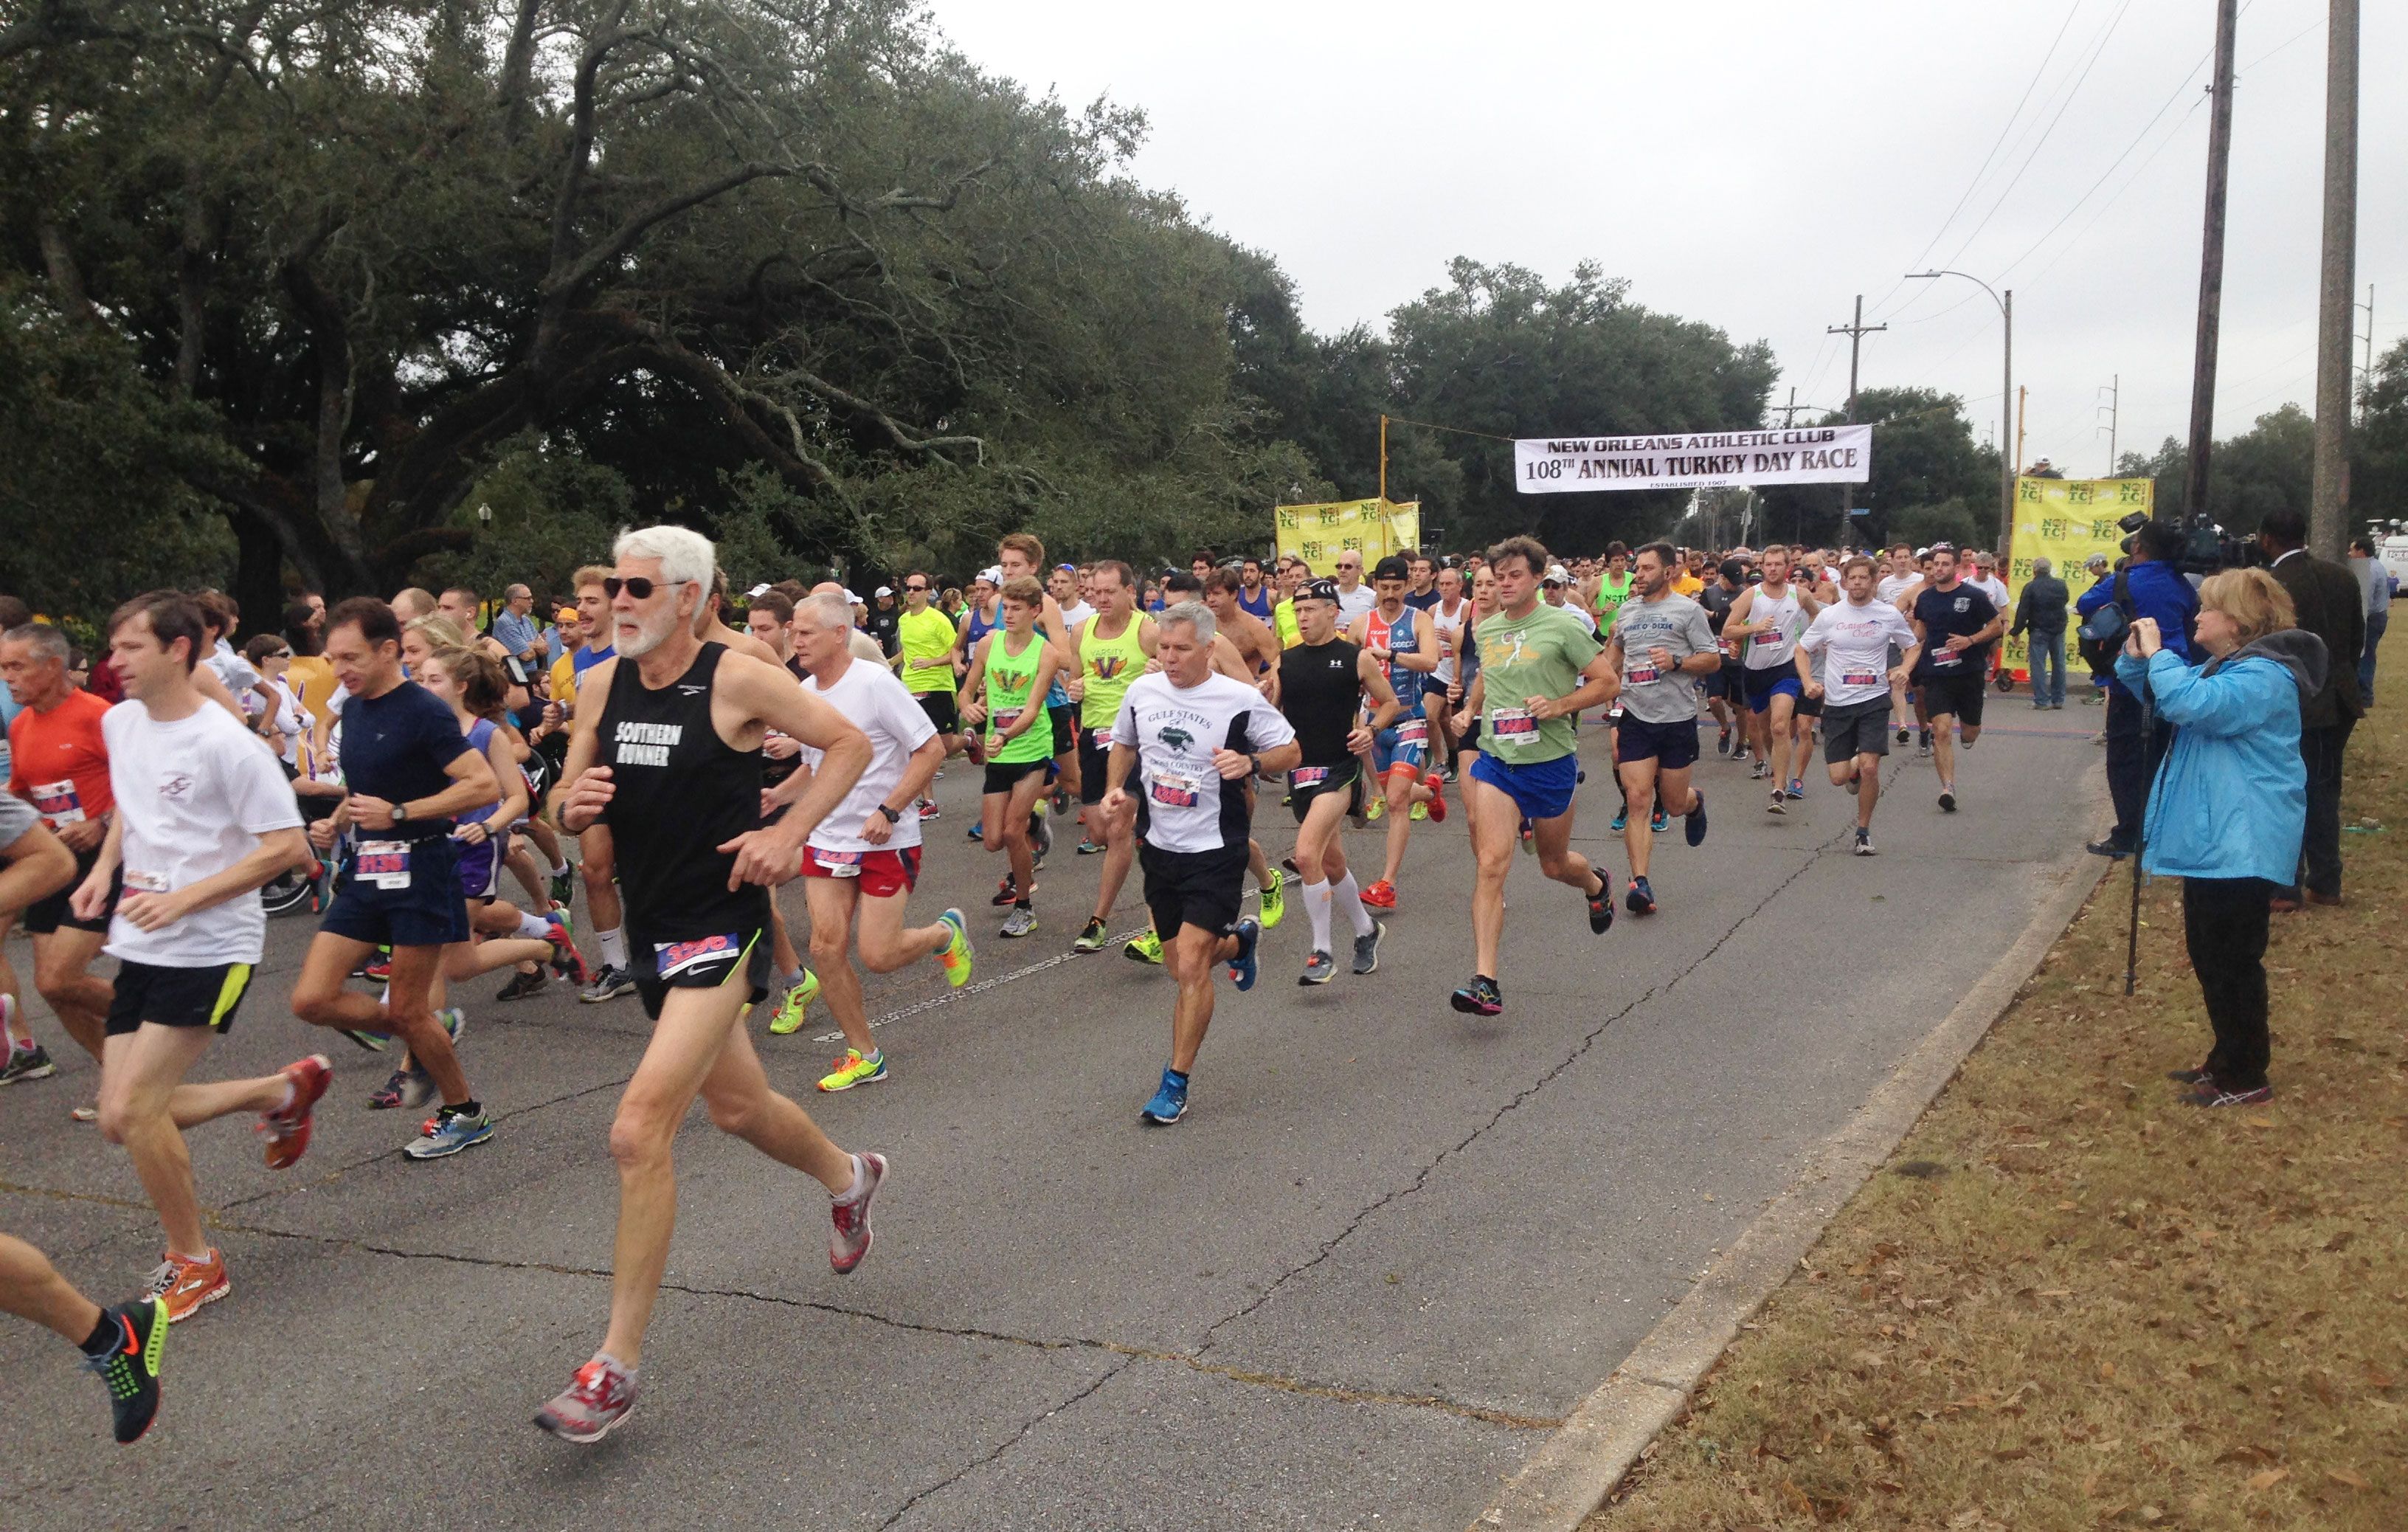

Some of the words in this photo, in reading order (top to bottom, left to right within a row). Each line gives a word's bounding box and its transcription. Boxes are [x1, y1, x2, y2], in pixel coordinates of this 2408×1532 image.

[1548, 440, 1591, 453] NEW
[1594, 437, 1683, 452] ORLEANS
[1686, 432, 1779, 449] ATHLETIC
[1783, 429, 1836, 444] CLUB
[1577, 458, 1660, 479] ANNUAL
[1665, 454, 1748, 477] TURKEY
[1753, 451, 1796, 472] DAY
[1801, 447, 1858, 470] RACE
[1149, 710, 1174, 722] GULF
[1176, 711, 1213, 729] STATES
[614, 721, 683, 745] SOUTHERN
[616, 743, 670, 767] RUNNER
